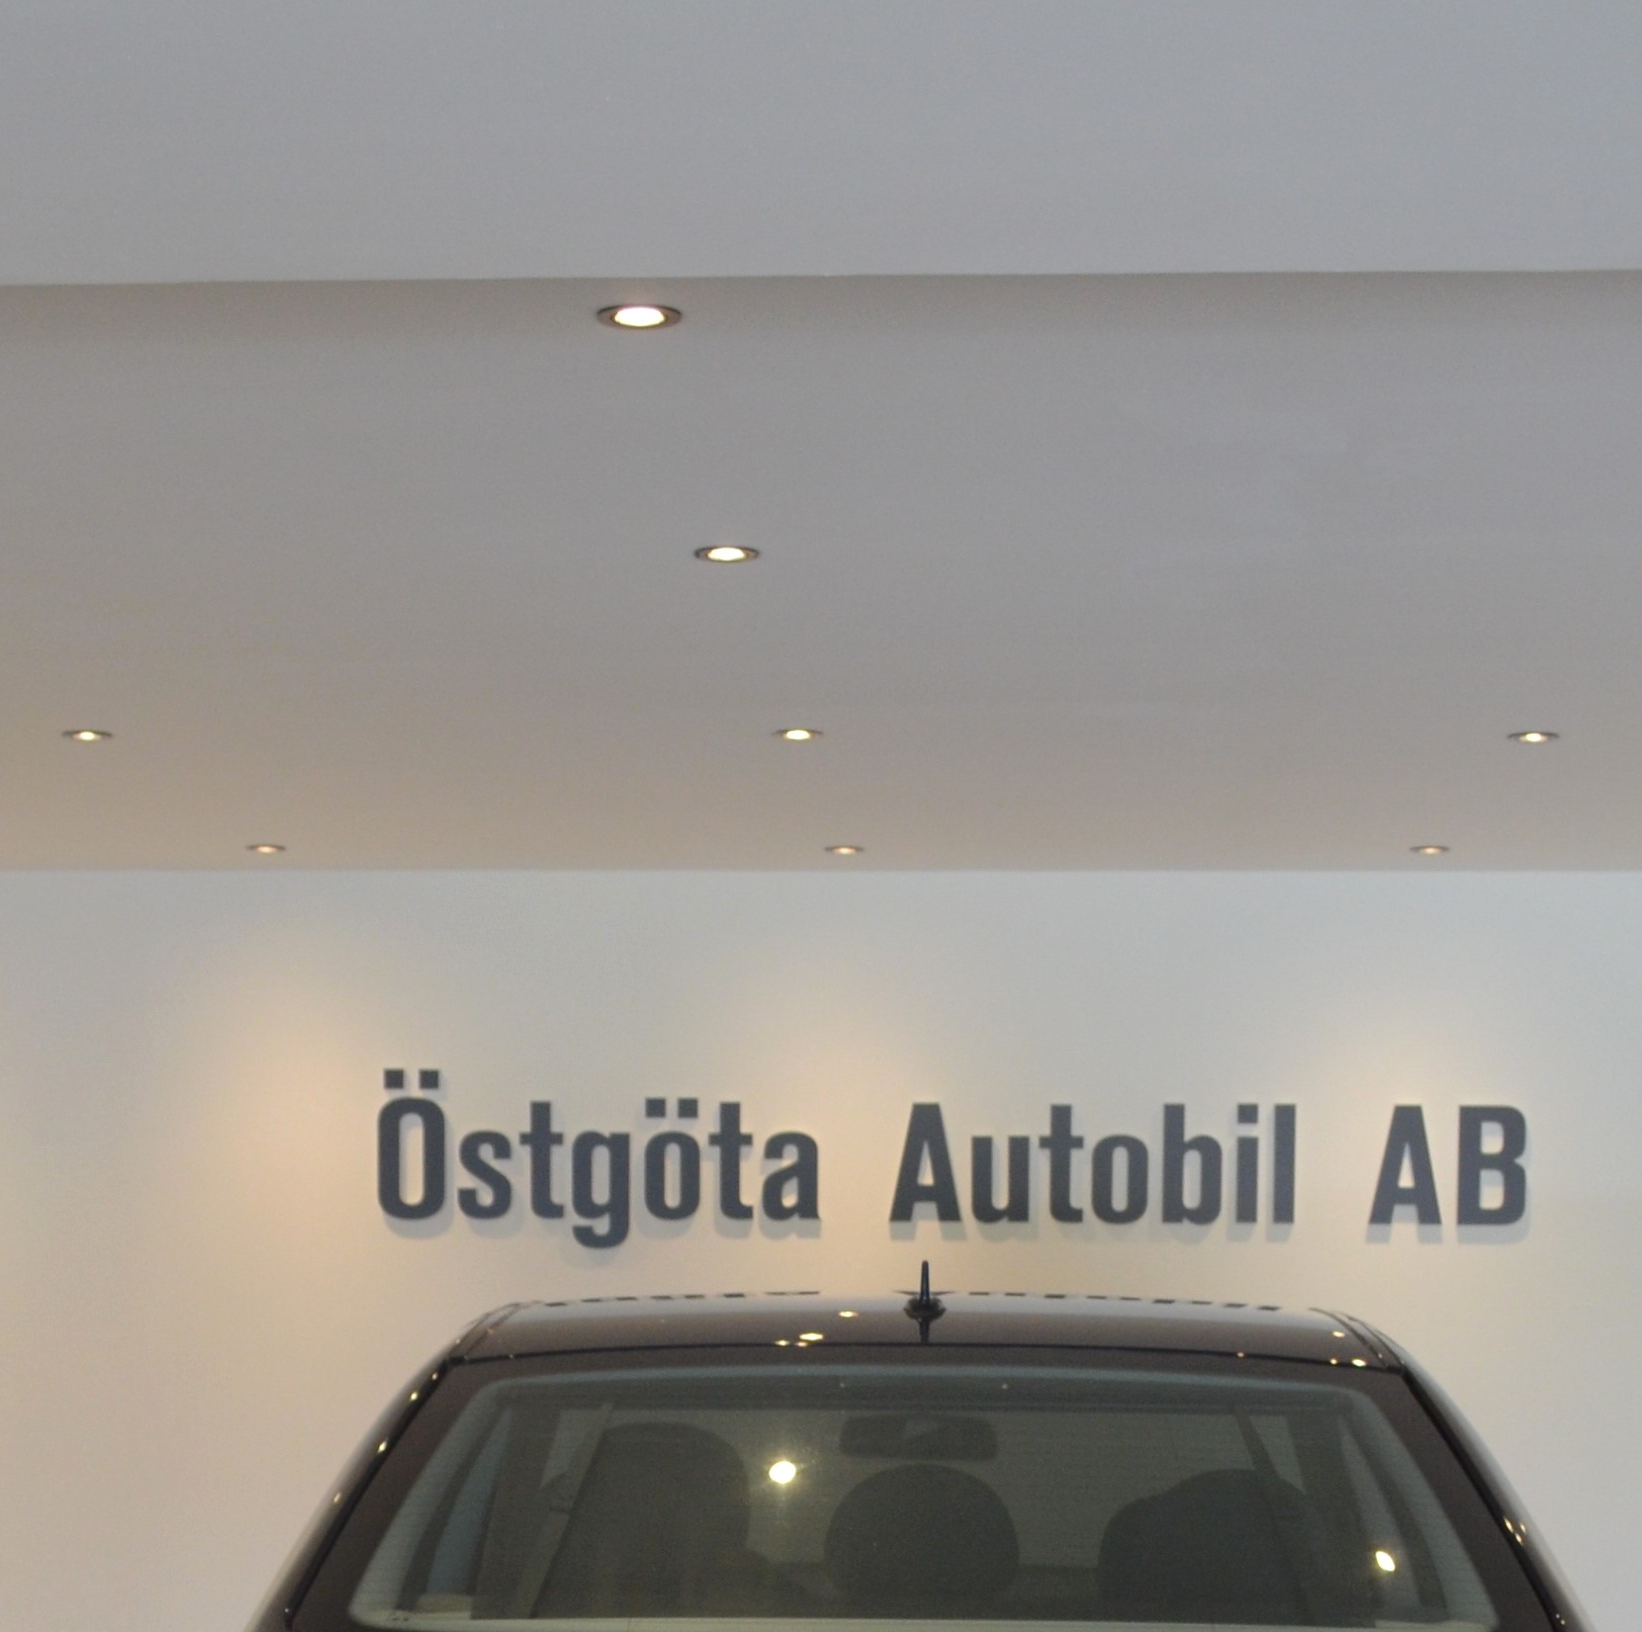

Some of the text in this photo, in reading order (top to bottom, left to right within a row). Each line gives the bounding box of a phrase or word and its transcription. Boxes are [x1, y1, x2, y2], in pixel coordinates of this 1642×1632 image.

[377, 1068, 1527, 1249] Östgöta Autobil AB
